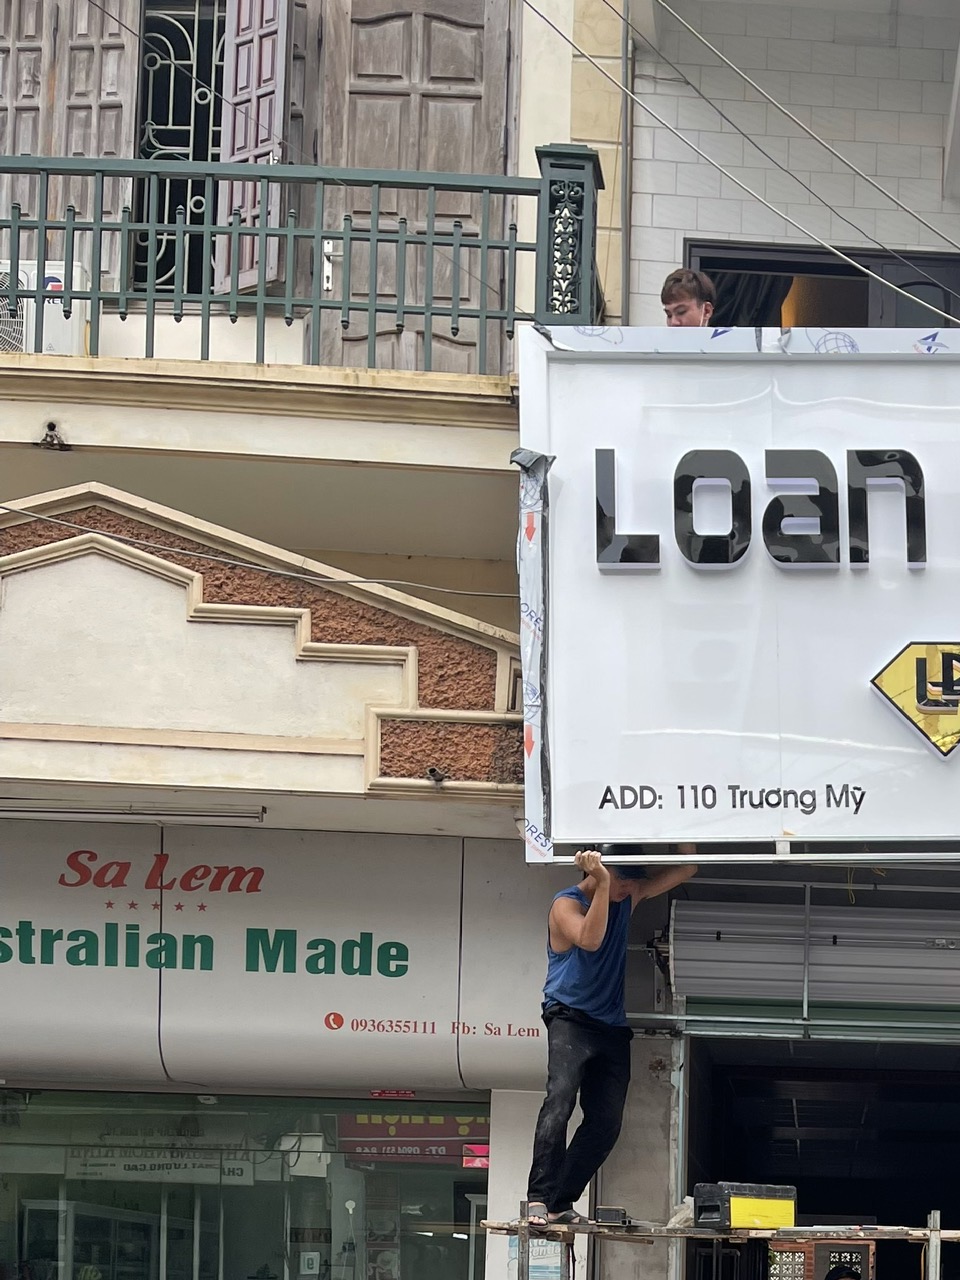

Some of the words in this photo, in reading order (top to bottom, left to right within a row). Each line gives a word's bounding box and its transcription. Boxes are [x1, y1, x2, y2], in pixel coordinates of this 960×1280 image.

[598, 785, 663, 809] ADD:
[677, 784, 717, 809] 110
[728, 784, 817, 815] Trương
[825, 783, 867, 815] Mỹ
[58, 850, 132, 888] Sa
[145, 853, 265, 893] Lem
[246, 928, 410, 978] Made
[351, 1018, 437, 1034] 0936355111
[484, 1022, 501, 1036] Sa
[507, 1024, 540, 1037] Lem
